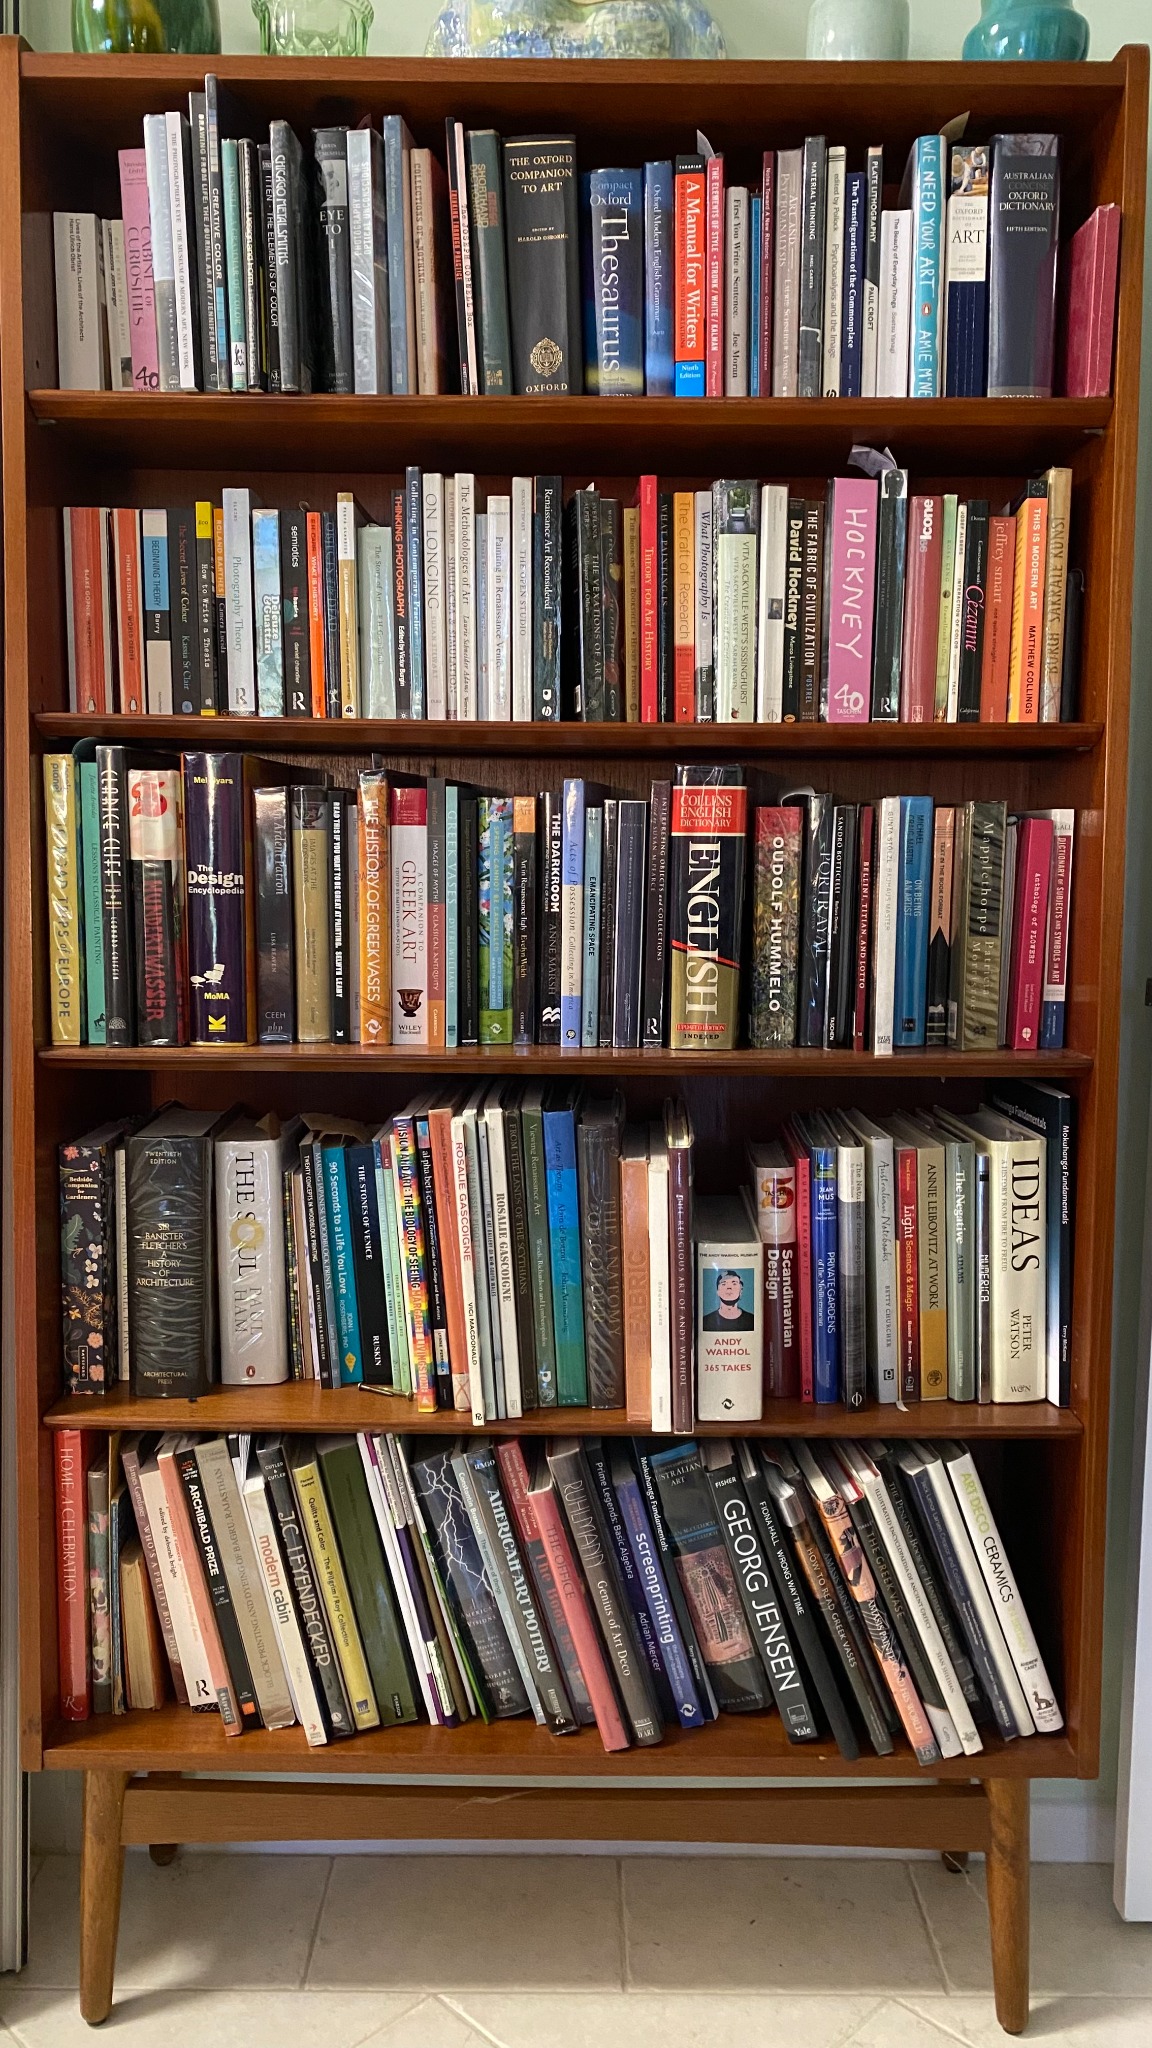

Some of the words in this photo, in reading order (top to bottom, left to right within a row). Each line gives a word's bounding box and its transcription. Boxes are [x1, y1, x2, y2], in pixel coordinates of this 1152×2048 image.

[510, 157, 530, 165] THE
[534, 155, 572, 164] OXFORD
[921, 139, 936, 162] WE
[275, 154, 286, 196] CHICAGO
[510, 168, 572, 180] COMPANION
[541, 182, 562, 192] ART
[686, 180, 701, 193] A
[921, 171, 936, 211] NEED
[1004, 172, 1054, 180] AUSTRALIAN
[213, 188, 221, 239] CREATIVE
[590, 193, 631, 206] Oxford
[1000, 202, 1055, 211] DICTIONARY
[1009, 192, 1047, 200] OXFORD
[276, 199, 288, 265] METALSMITHS
[686, 197, 701, 258] Manual
[921, 218, 936, 249] YOUR
[214, 243, 222, 279] COLOR
[686, 262, 701, 285] for
[920, 257, 935, 298] ART
[602, 208, 629, 371] Thesaurus
[686, 289, 701, 348] Writers
[526, 383, 568, 392] OXFORD
[394, 495, 403, 541] THINKING
[426, 493, 438, 519] ON
[544, 489, 553, 537] Renaissance
[808, 510, 817, 529] THE
[1032, 508, 1041, 530] THIS
[291, 526, 300, 567] semiotics
[544, 539, 553, 553] Art
[790, 520, 802, 561] David
[807, 534, 817, 572] FABRIC
[994, 521, 1008, 562] jeffrey
[1032, 534, 1040, 542] IS
[151, 541, 160, 578] BEGINNING
[426, 530, 439, 609] LONGING
[645, 547, 654, 584] THEORY
[1030, 546, 1039, 587] MODERN
[152, 581, 161, 606] THEORY
[395, 544, 404, 618] PHOTOGRAPHY
[544, 556, 552, 609] Reconsidered
[645, 589, 654, 605] FOR
[785, 567, 801, 630] Hockney
[806, 577, 816, 589] OF
[836, 508, 868, 659] HOCKNEY
[994, 566, 1006, 603] smart
[271, 595, 279, 640] Deleuze
[645, 608, 653, 628] ART
[965, 585, 984, 651] Cézanne
[1030, 591, 1038, 610] ART
[805, 593, 816, 665] CIVILIZATION
[645, 631, 653, 672] HISTORY
[1027, 626, 1036, 668] MATTHEW
[1025, 671, 1035, 714] COLLINGS
[366, 800, 379, 824] THE
[681, 795, 732, 806] COLLINS
[681, 807, 731, 818] ENGLISH
[552, 813, 560, 836] THE
[680, 819, 730, 827] DICTIONARY
[366, 829, 379, 887] HISTORY
[770, 836, 783, 911] OUDOLF
[188, 871, 243, 885] Design
[189, 886, 244, 895] Encyclopedia
[402, 860, 416, 921] GREEK
[551, 841, 560, 912] DARKROOM
[861, 862, 869, 900] BELLINI,
[978, 822, 993, 932] Mapplethorpe
[366, 890, 379, 909] OF
[588, 877, 596, 930] EMANCIPATING
[367, 913, 379, 955] GREEK
[403, 928, 416, 963] ART
[686, 841, 720, 1015] ENGLISH
[367, 957, 380, 1000] VASES
[769, 918, 783, 1011] HUMMELO
[859, 961, 867, 988] LOTTO
[329, 1162, 339, 1173] 90
[358, 1165, 366, 1180] THE
[455, 1142, 466, 1189] ROSALIE
[927, 1164, 938, 1197] ANNIE
[954, 1170, 965, 1192] The
[330, 1175, 342, 1213] Seconds
[359, 1183, 369, 1213] STONES
[333, 1216, 343, 1225] to
[362, 1216, 370, 1227] OF
[459, 1193, 471, 1261] GASCOIGNE
[903, 1205, 915, 1238] Light
[928, 1201, 938, 1255] LEIBOVITZ
[954, 1194, 965, 1244] Negative
[1011, 1157, 1040, 1271] IDEAS
[334, 1234, 345, 1250] Life
[363, 1230, 372, 1260] VENICE
[905, 1240, 914, 1273] Science
[335, 1253, 346, 1271] You
[766, 1250, 780, 1299] Design
[928, 1258, 938, 1271] AT
[136, 1278, 194, 1286] ARCHITECTURE
[337, 1273, 348, 1294] Love
[782, 1250, 793, 1347] Scandinavian
[905, 1285, 914, 1311] Magic
[928, 1273, 939, 1309] WORK
[372, 1335, 382, 1365] RUSKIN
[1010, 1309, 1020, 1359] WATSON
[1022, 1315, 1031, 1351] PETER
[595, 1462, 610, 1486] Prime
[960, 1472, 978, 1494] ART
[61, 1496, 74, 1504] A
[602, 1488, 620, 1524] Legends:
[639, 1457, 657, 1500] Mokuhanga
[649, 1501, 669, 1551] Fundamentals
[759, 1502, 774, 1525] FIONA
[967, 1498, 990, 1533] DECO
[188, 1485, 212, 1543] ARCHIBALD
[202, 1547, 219, 1576] PRIZE
[277, 1512, 300, 1541] J.C.
[487, 1491, 523, 1572] AMERICAN
[612, 1525, 626, 1546] Basic
[767, 1527, 781, 1546] HALL
[62, 1508, 77, 1602] CELEBRATION
[617, 1547, 635, 1579] Algebra
[775, 1550, 792, 1579] WRONG
[982, 1537, 1014, 1602] CERAMICS
[258, 1536, 282, 1587] modern
[271, 1590, 291, 1624] cabin
[510, 1575, 532, 1604] ART
[635, 1533, 676, 1644] screenprinting
[723, 1500, 771, 1592] GEORG
[752, 1600, 799, 1691] JENSEN
[785, 1581, 798, 1597] WAY
[286, 1547, 330, 1666] LEYENDECKER
[597, 1581, 616, 1616] Genius
[791, 1599, 804, 1615] TIME
[520, 1608, 552, 1673] POTTERY
[606, 1619, 620, 1630] of
[610, 1632, 624, 1647] Art
[614, 1650, 632, 1676] Deco
